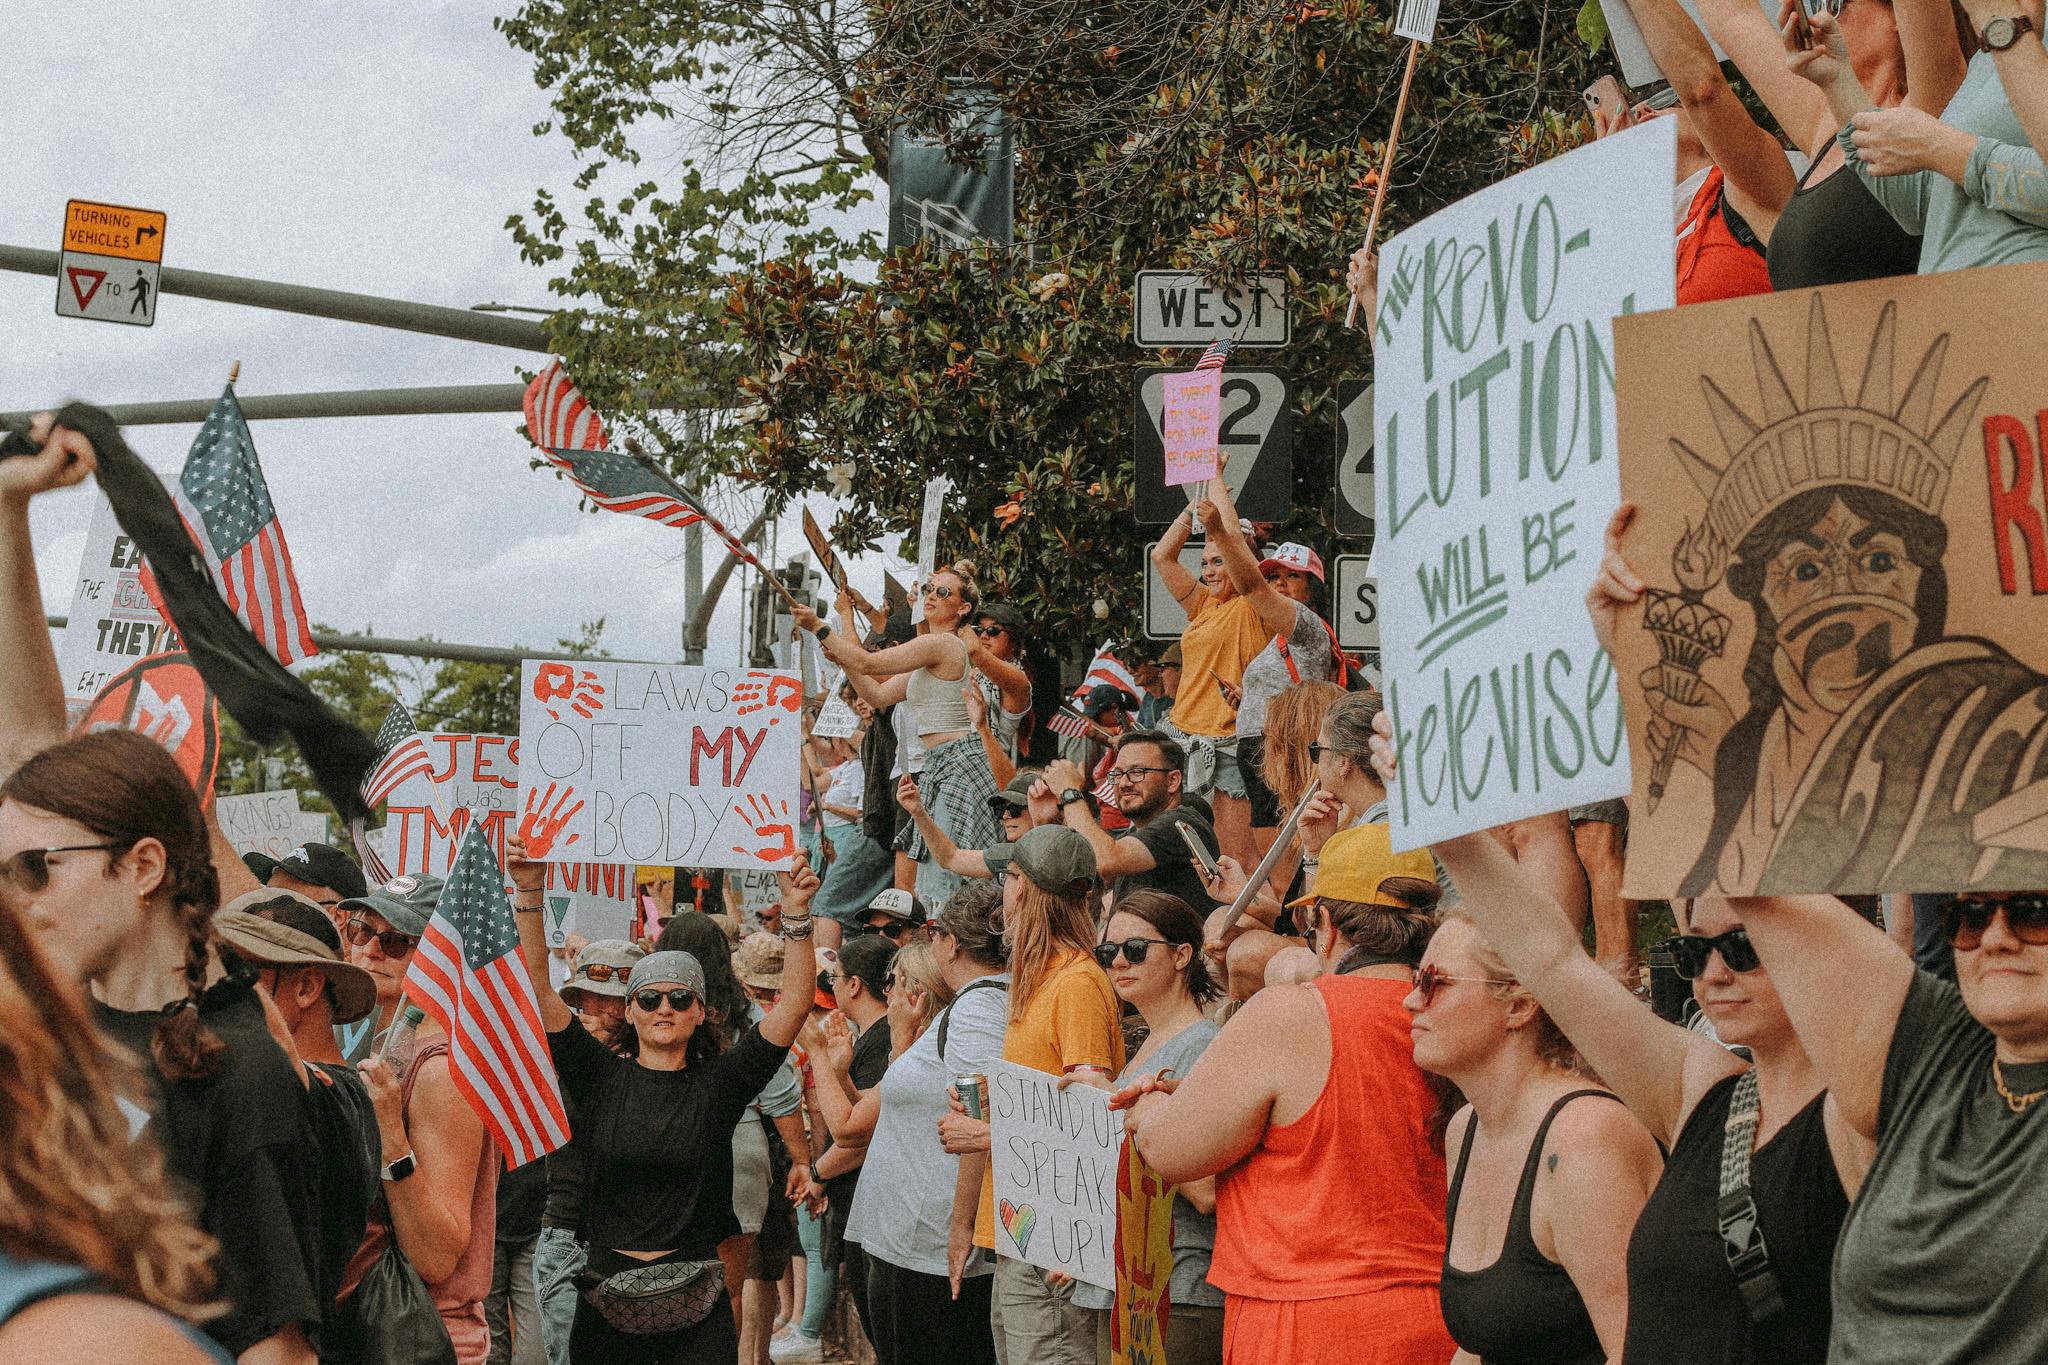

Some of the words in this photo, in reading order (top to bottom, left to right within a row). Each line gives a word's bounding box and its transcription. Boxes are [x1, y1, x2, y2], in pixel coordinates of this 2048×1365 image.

[69, 228, 130, 249] VEHICLES
[73, 208, 130, 229] TURNING
[106, 282, 121, 296] TO
[1158, 288, 1267, 328] WEST
[1377, 244, 1423, 347] THE
[1416, 523, 1506, 624] WILL
[1521, 499, 1577, 586] BE
[79, 579, 106, 600] THE
[614, 669, 730, 713] LAWS
[537, 722, 643, 781] OFF
[690, 726, 768, 787] MY
[223, 796, 292, 836] KINGS
[593, 790, 733, 863] BODY
[997, 1072, 1084, 1141] STAND
[1008, 1135, 1115, 1216] SPEAK
